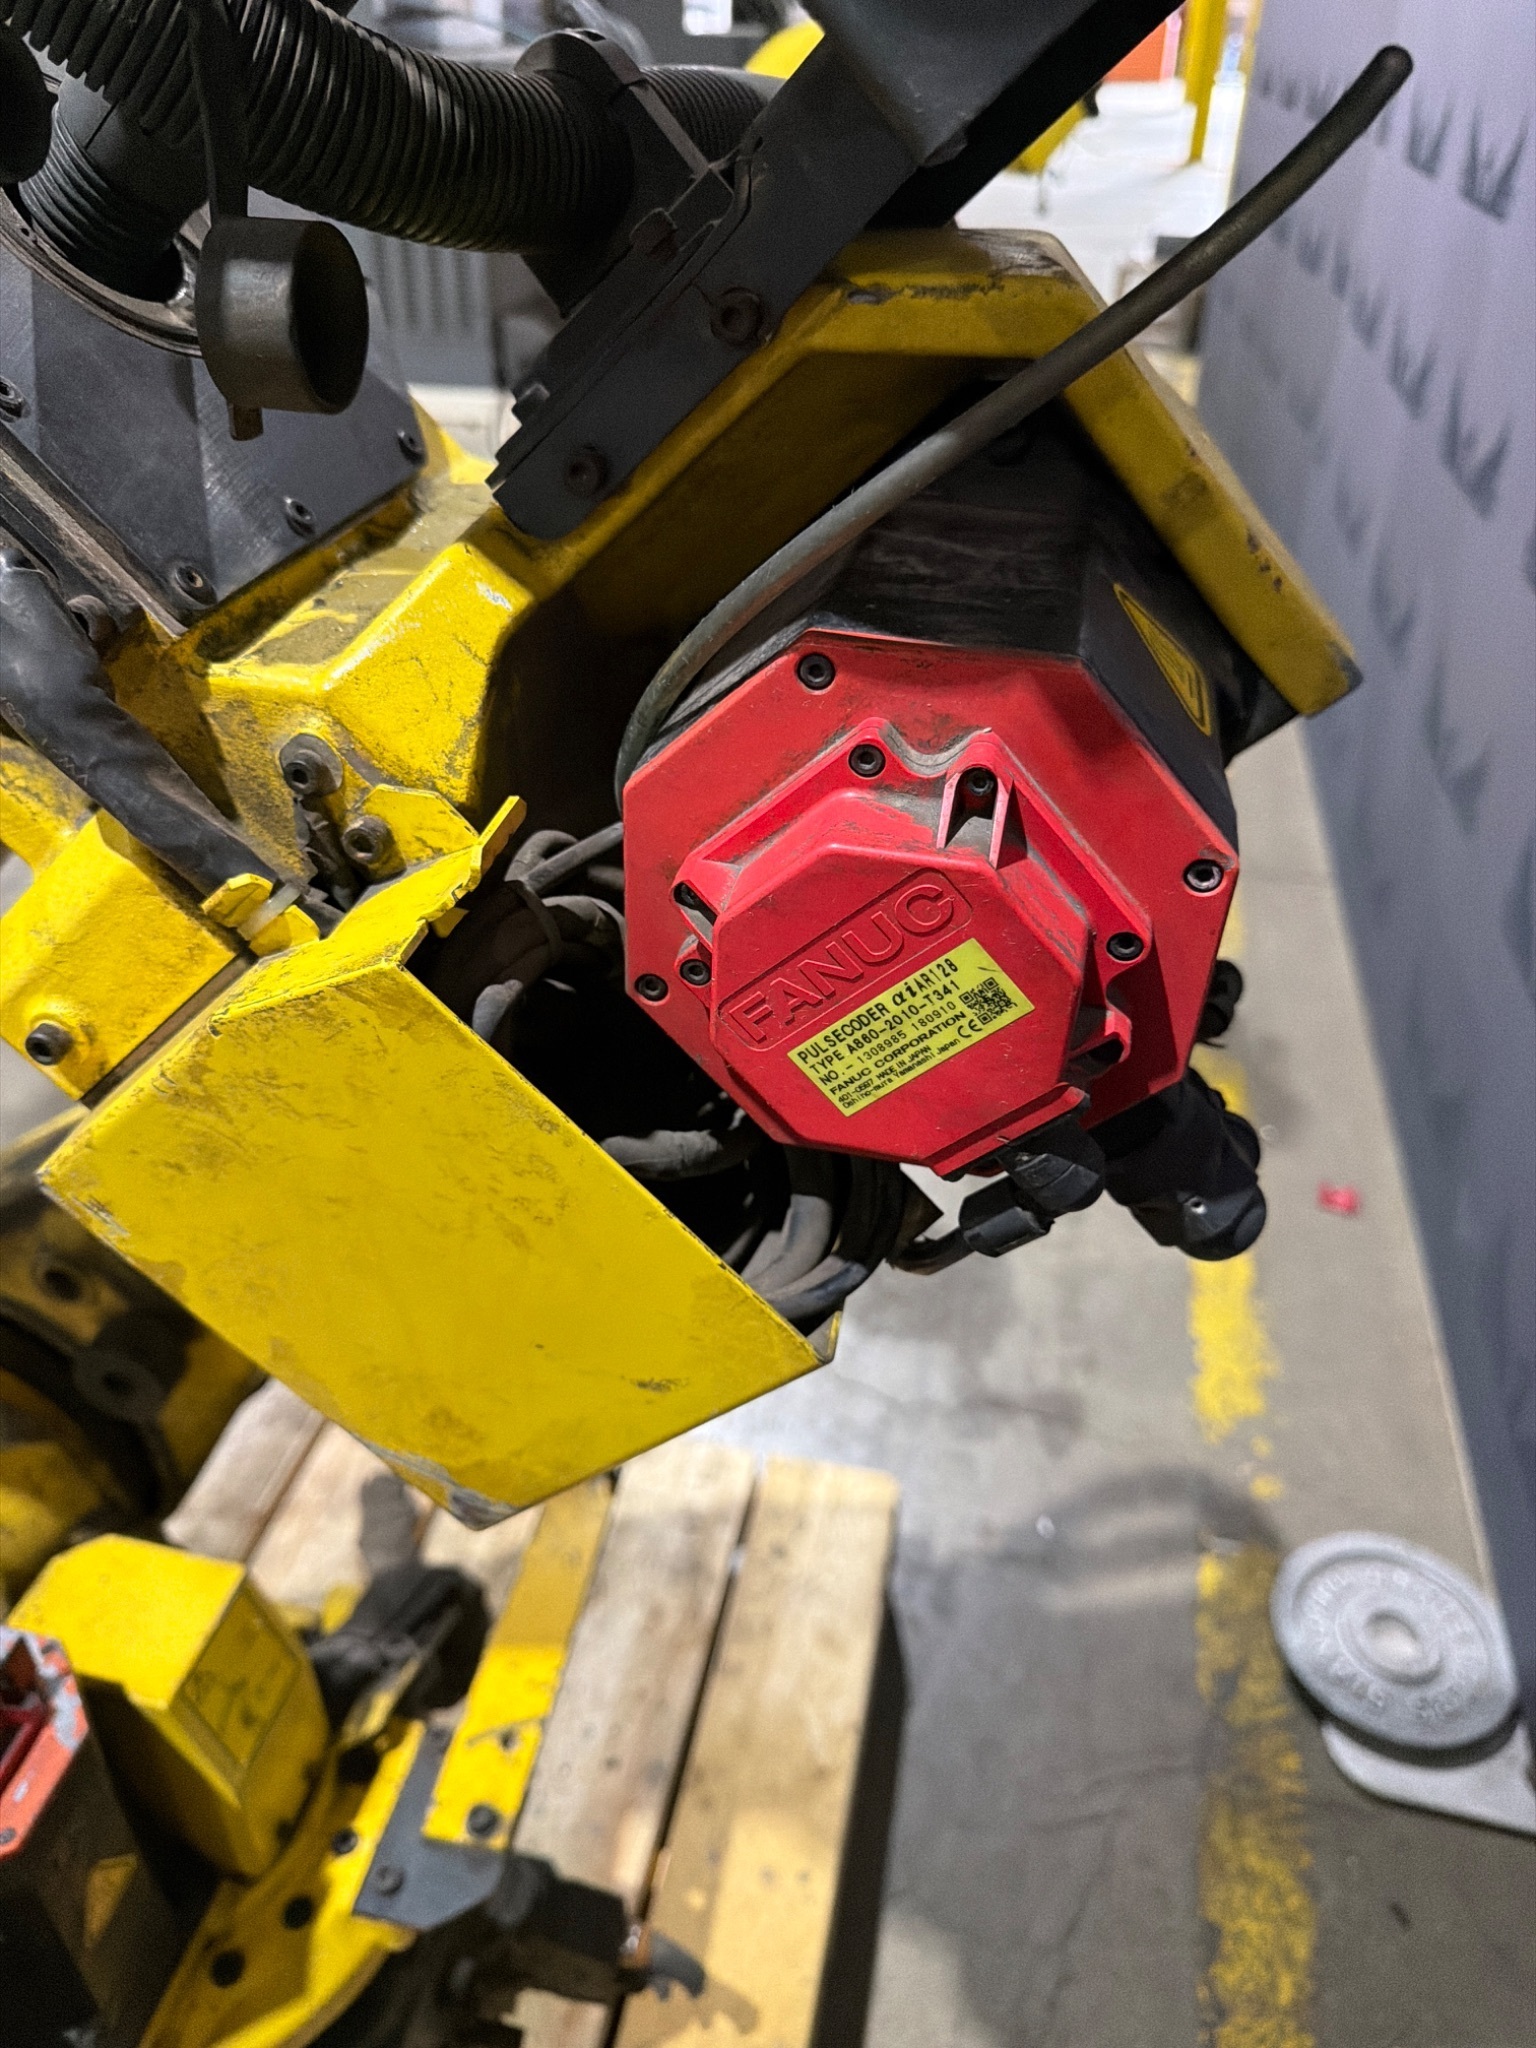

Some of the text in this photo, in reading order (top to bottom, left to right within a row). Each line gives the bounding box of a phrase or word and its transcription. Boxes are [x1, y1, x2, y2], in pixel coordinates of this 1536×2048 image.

[729, 884, 954, 1043] FANUC
[796, 1002, 891, 1065] PULSECODER
[808, 979, 960, 1074] TYPE A860-2010-T341
[829, 1010, 967, 1096] FANUC CORPORATION
[856, 1029, 907, 1064] 1308985
[911, 1001, 956, 1031] 180910
[937, 1038, 961, 1055] Japan
[875, 1065, 897, 1081] MADE
[895, 1059, 907, 1069] IN
[908, 1044, 932, 1063] JAPAN
